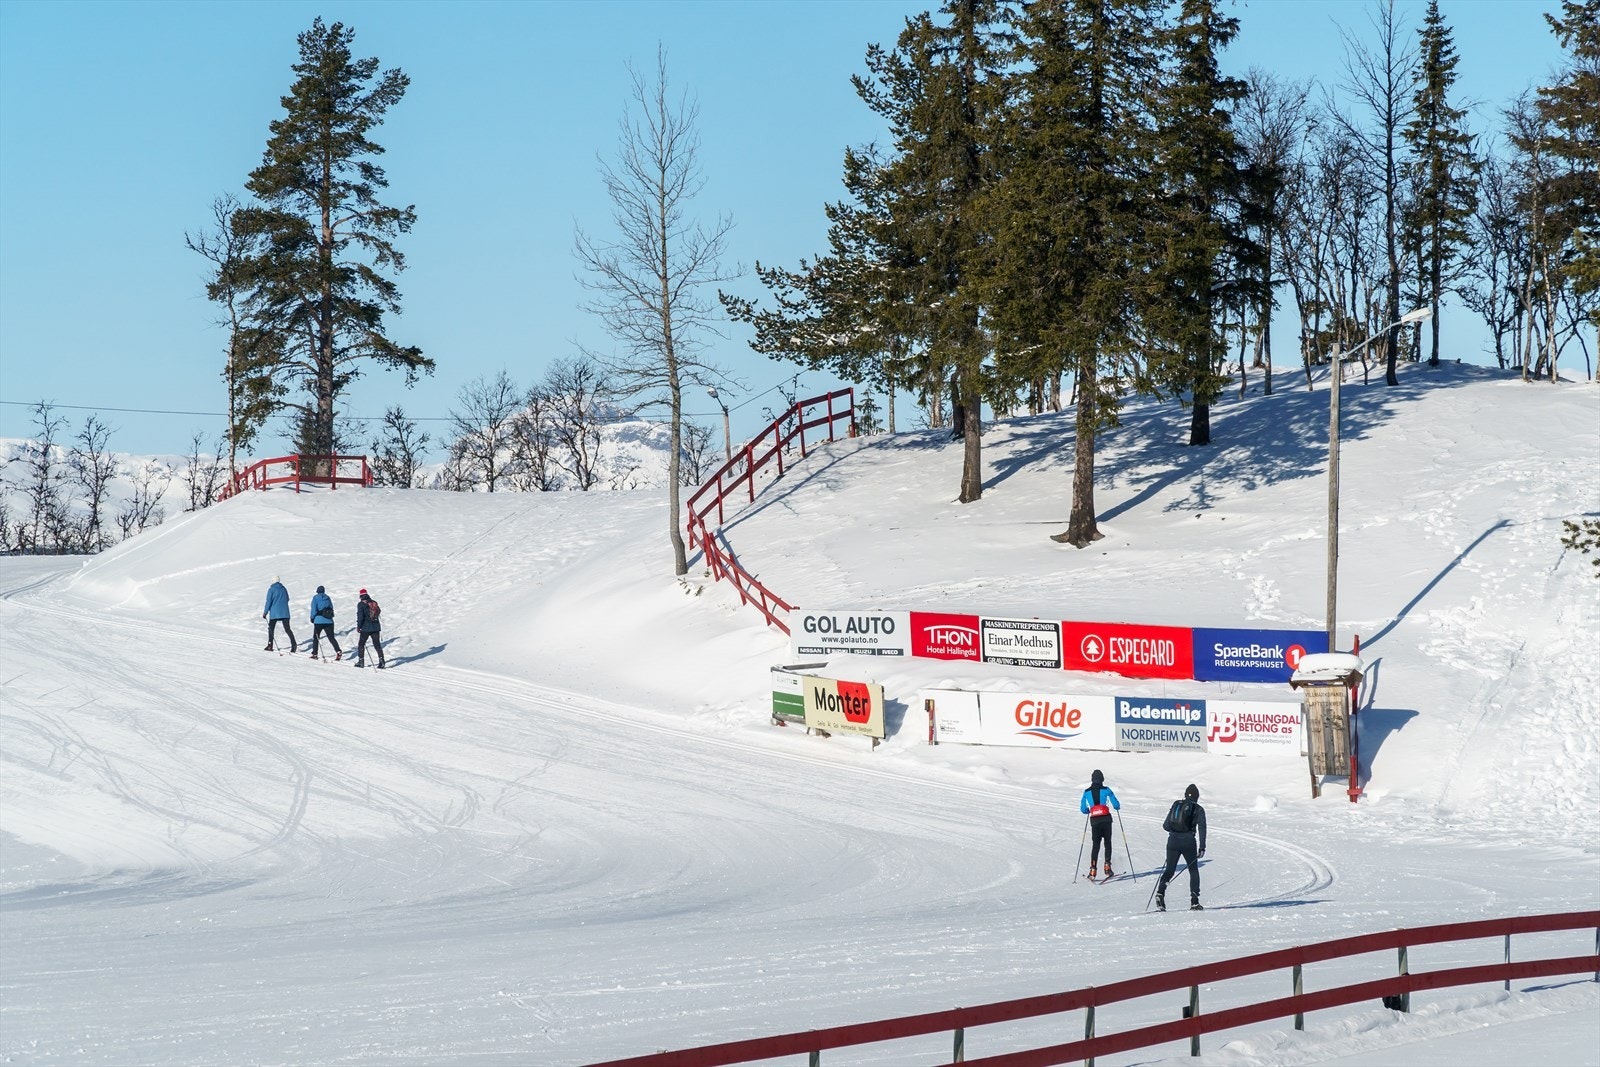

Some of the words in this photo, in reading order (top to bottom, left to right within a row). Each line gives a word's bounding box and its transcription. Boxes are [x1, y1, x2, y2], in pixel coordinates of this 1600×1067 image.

[803, 615, 842, 633] GOL
[845, 616, 896, 635] AUTO
[984, 620, 1056, 631] MASKINENTREPRENØR
[821, 636, 879, 644] www.golauto.no
[923, 625, 979, 646] THON
[988, 633, 1012, 647] Einar
[1014, 635, 1053, 648] Medhus
[926, 645, 946, 654] Hotel
[946, 647, 977, 657] Hallingdal
[1110, 637, 1175, 667] ESPEGARD
[1214, 643, 1284, 659] SpareBank
[1291, 648, 1300, 665] 1
[1017, 659, 1056, 667] TRANSPORT
[1214, 659, 1284, 669] REGNSKAPSHUSET
[1015, 700, 1081, 729] Gilde
[1120, 700, 1201, 725] Bademiljø
[1238, 713, 1301, 725] HALLINGDAL
[1207, 711, 1238, 743] HB
[1239, 723, 1279, 733] BETONG
[1281, 726, 1293, 734] as
[1121, 728, 1179, 742] NORDHEIM
[1180, 731, 1201, 743] VVS
